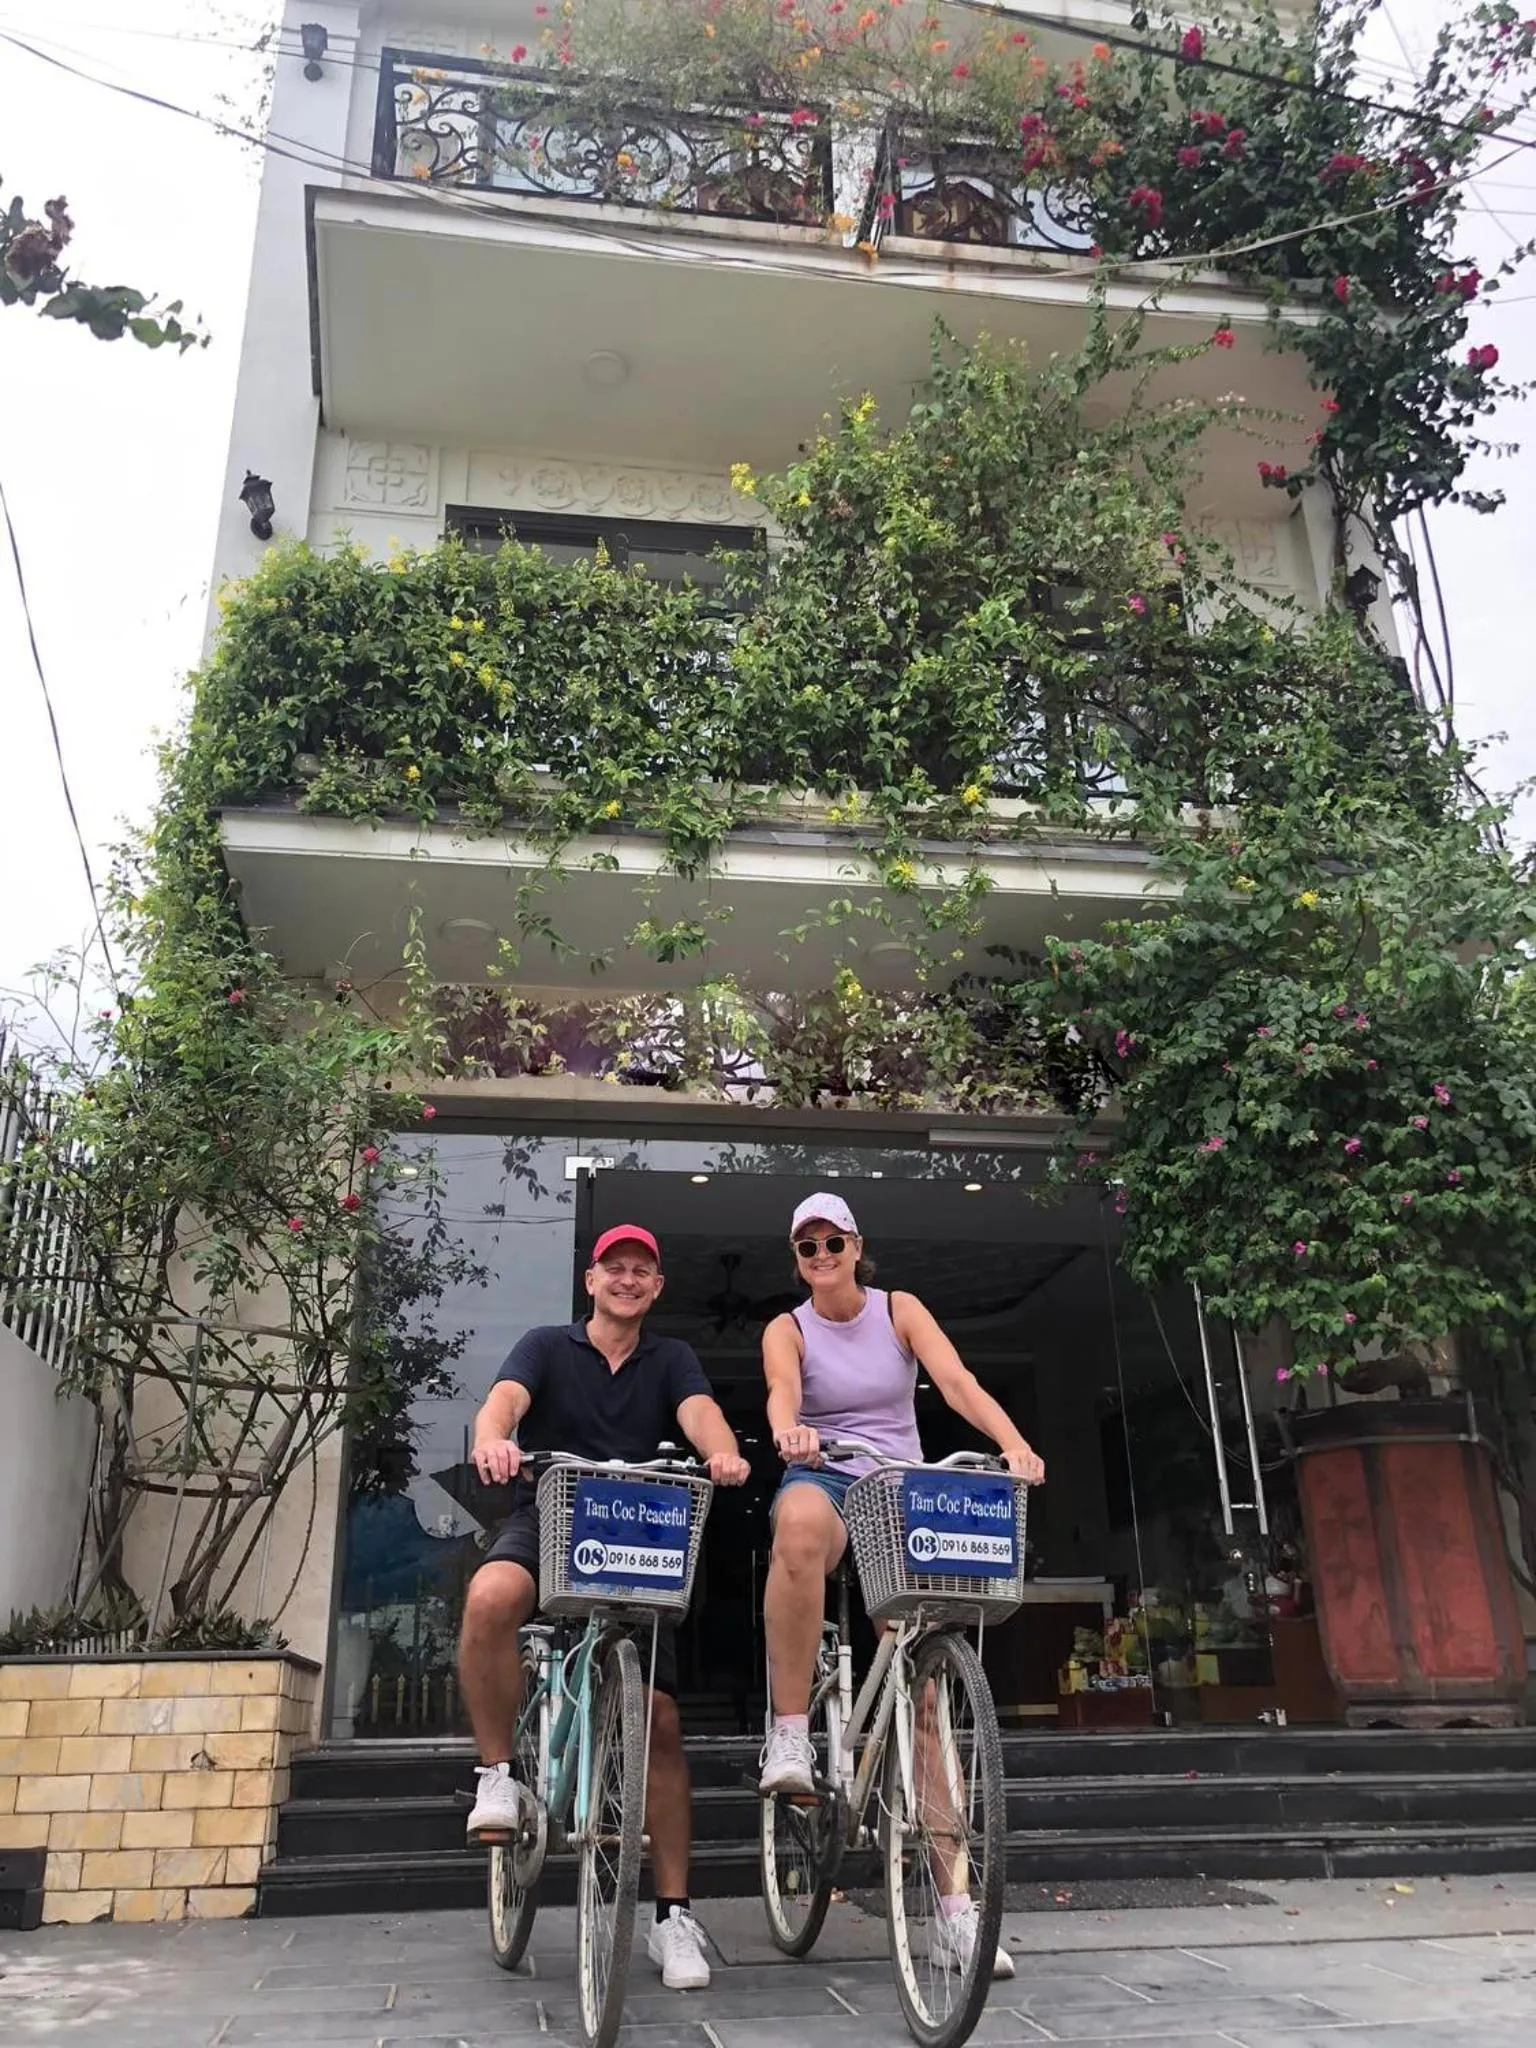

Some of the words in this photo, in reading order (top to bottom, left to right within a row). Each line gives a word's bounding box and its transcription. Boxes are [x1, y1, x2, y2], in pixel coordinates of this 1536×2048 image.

[584, 1497, 609, 1519] Tam
[612, 1500, 635, 1521] Coc
[638, 1502, 687, 1526] Peaceful
[909, 1491, 934, 1513] Tam
[937, 1493, 960, 1514] Coc
[963, 1497, 1011, 1519] Peaceful
[911, 1535, 937, 1553] 03
[942, 1539, 967, 1553] 0916
[971, 1541, 989, 1554] 868
[992, 1543, 1010, 1556] 569
[577, 1547, 604, 1566] 08
[609, 1551, 636, 1566] 0916
[639, 1554, 658, 1568] 868
[662, 1556, 682, 1569] 569
